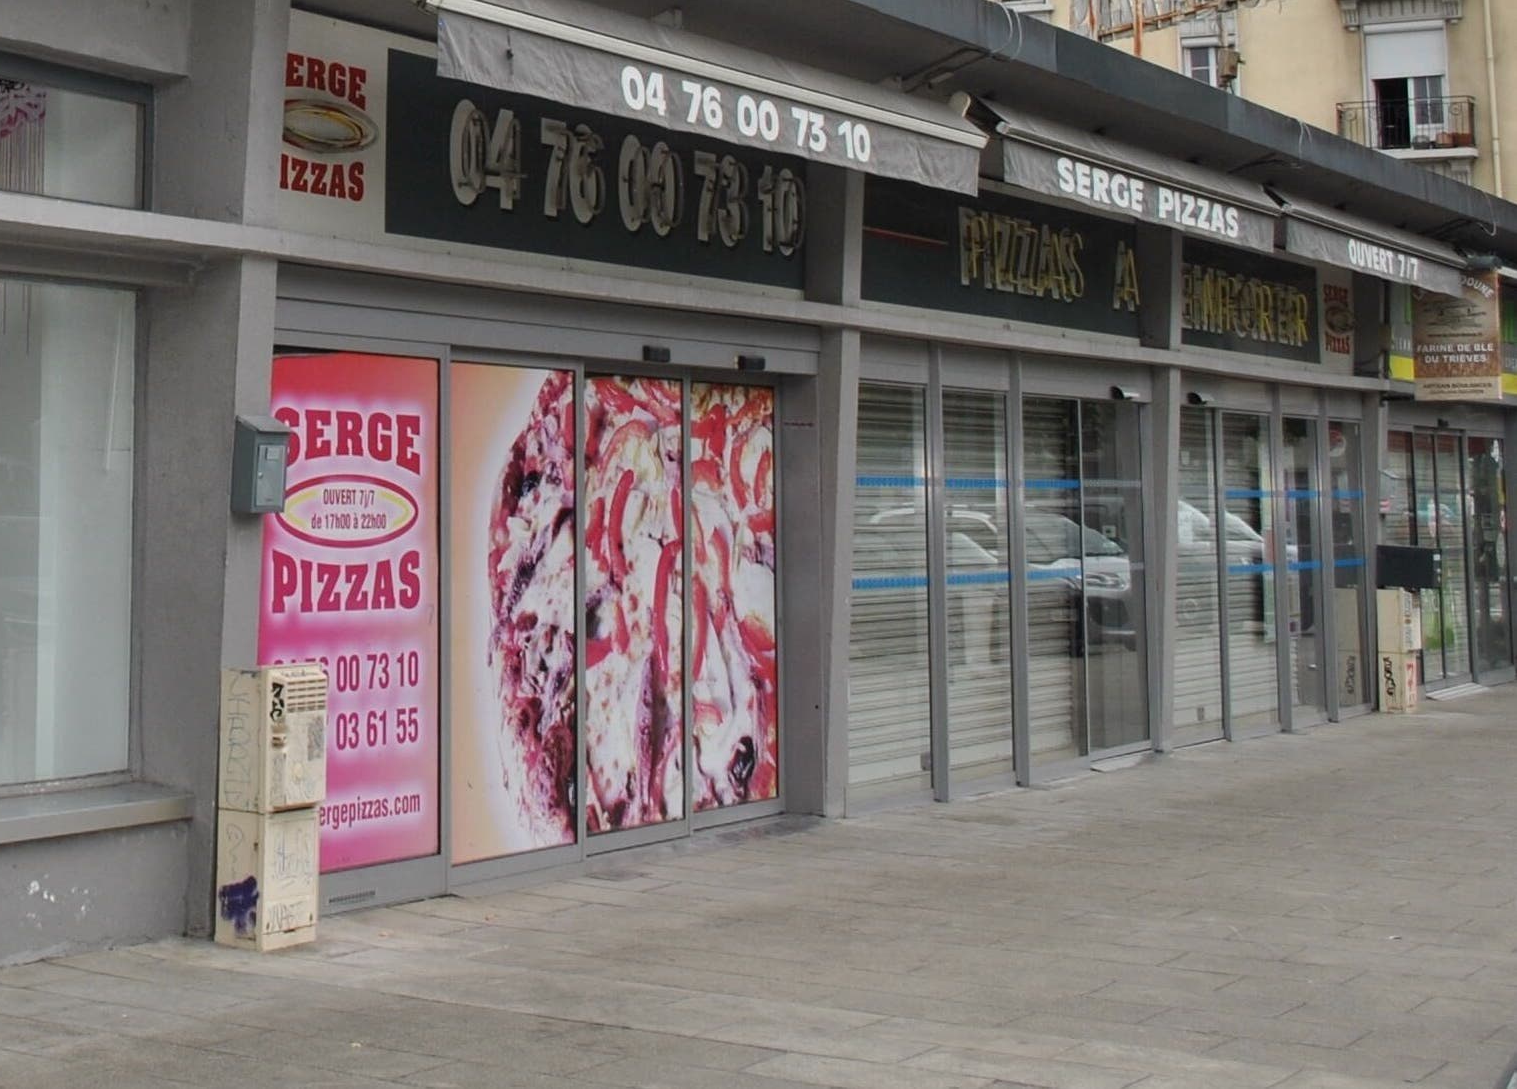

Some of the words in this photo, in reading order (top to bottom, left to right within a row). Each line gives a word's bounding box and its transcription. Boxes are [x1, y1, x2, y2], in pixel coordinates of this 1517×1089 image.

[285, 52, 367, 111] ERGE
[621, 65, 667, 116] 04
[682, 80, 723, 129] 76
[737, 94, 779, 142] 00
[791, 107, 827, 152] 73
[838, 120, 871, 163] 10
[279, 153, 364, 202] IZZAS
[449, 99, 522, 210] 04
[541, 117, 606, 224] 76
[618, 134, 682, 237] 00
[694, 151, 749, 247] 73
[757, 164, 806, 256] 10
[1057, 157, 1146, 213] SERGE
[1158, 186, 1239, 238] PIZZAS
[958, 206, 1084, 303] PIZZAS
[1347, 239, 1394, 275] OUVERT
[1397, 253, 1419, 281] 7/7
[1324, 332, 1350, 355] PIZZAS
[274, 406, 421, 476] SERGE
[311, 513, 322, 530] de
[325, 513, 351, 530] 17h00
[353, 513, 359, 529] à
[361, 512, 387, 529] 22h00
[323, 488, 357, 506] OUVERT
[272, 549, 421, 614] PIZZAS
[336, 654, 360, 692] 00
[367, 652, 390, 689] 73
[396, 650, 419, 687] 10
[336, 712, 360, 750] 03
[367, 709, 387, 747] 61
[396, 707, 419, 744] 55
[319, 793, 421, 830] ergepizzas.com
